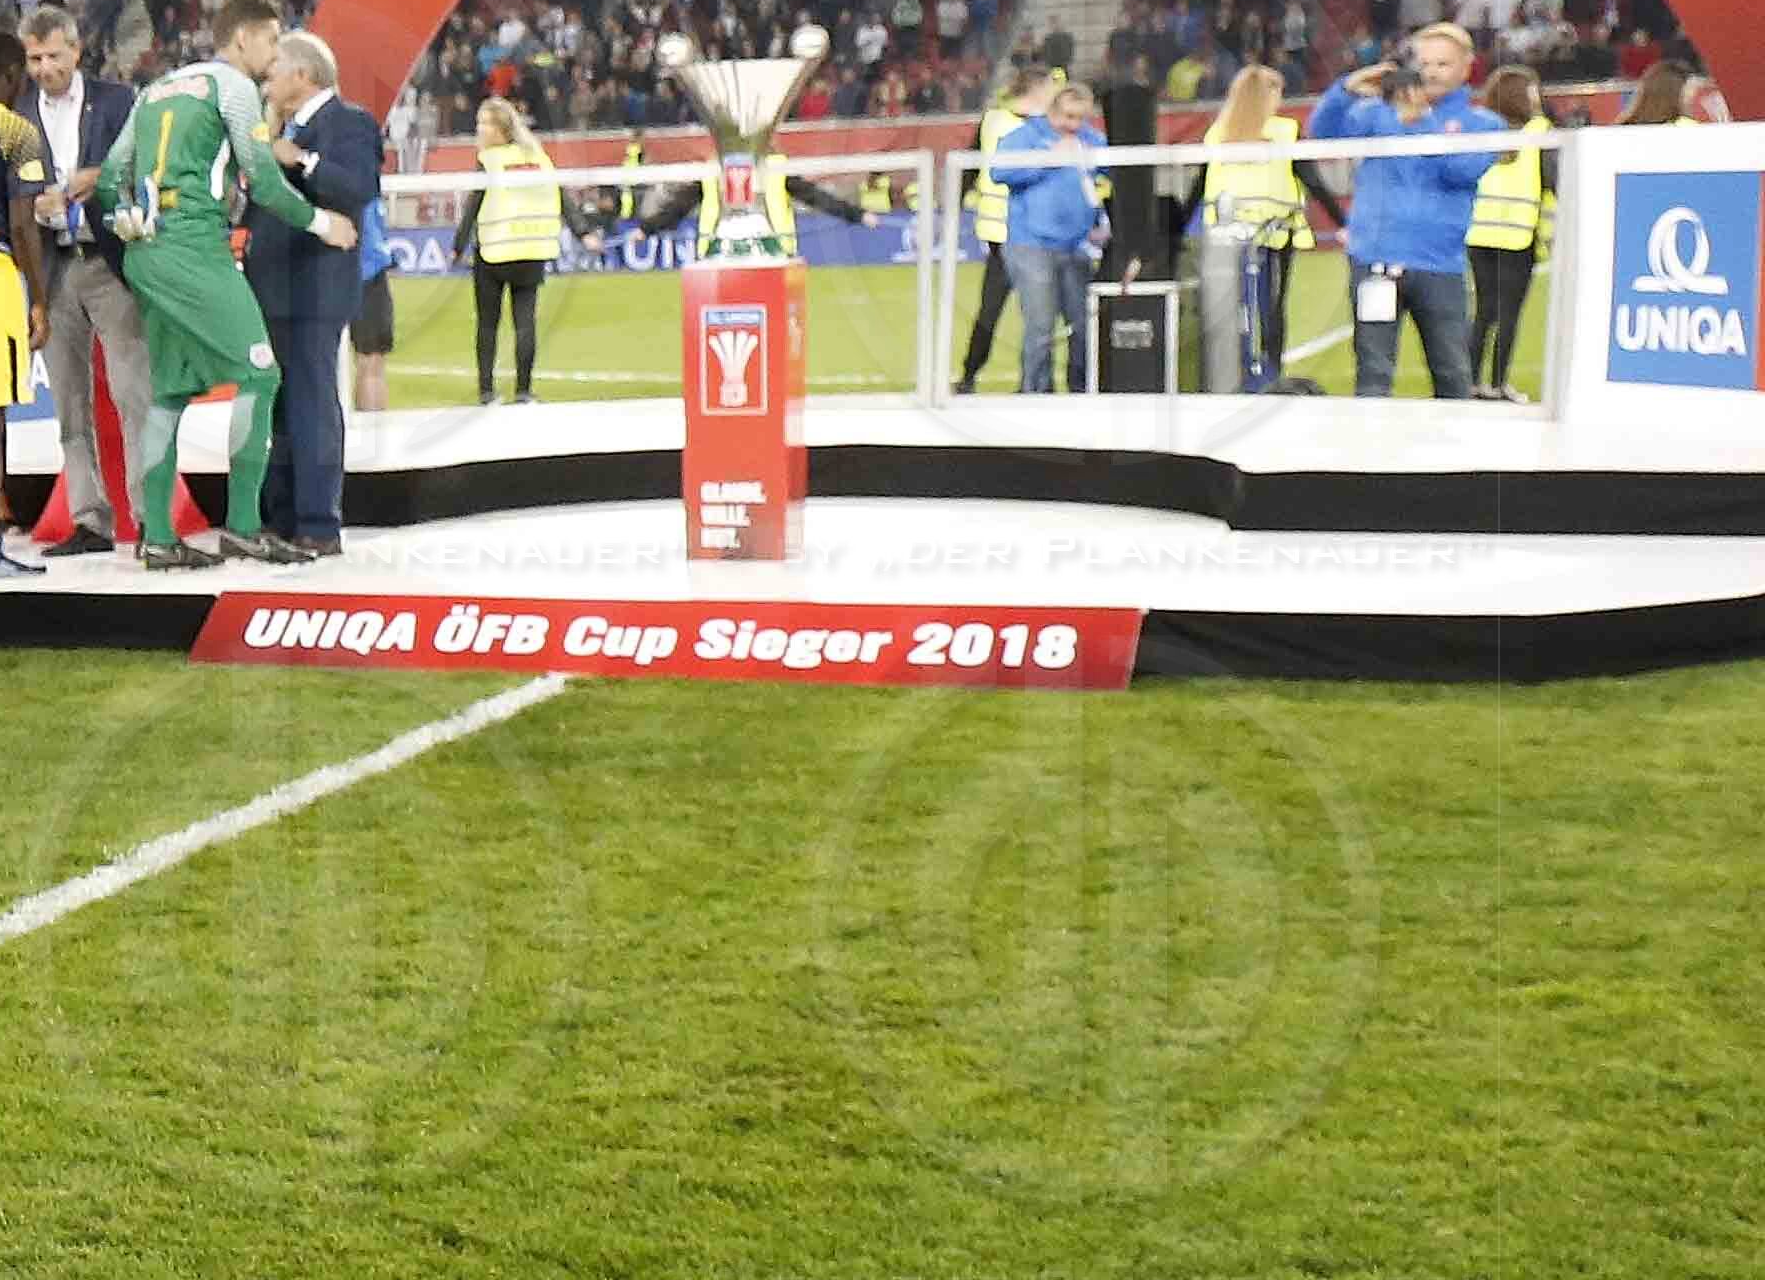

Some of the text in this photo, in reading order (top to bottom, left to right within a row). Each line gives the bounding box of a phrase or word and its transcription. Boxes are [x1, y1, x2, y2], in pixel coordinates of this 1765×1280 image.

[1615, 303, 1748, 356] UNIQA
[243, 604, 1080, 670] UNIQA ÖFB Cup Sieger 2018
